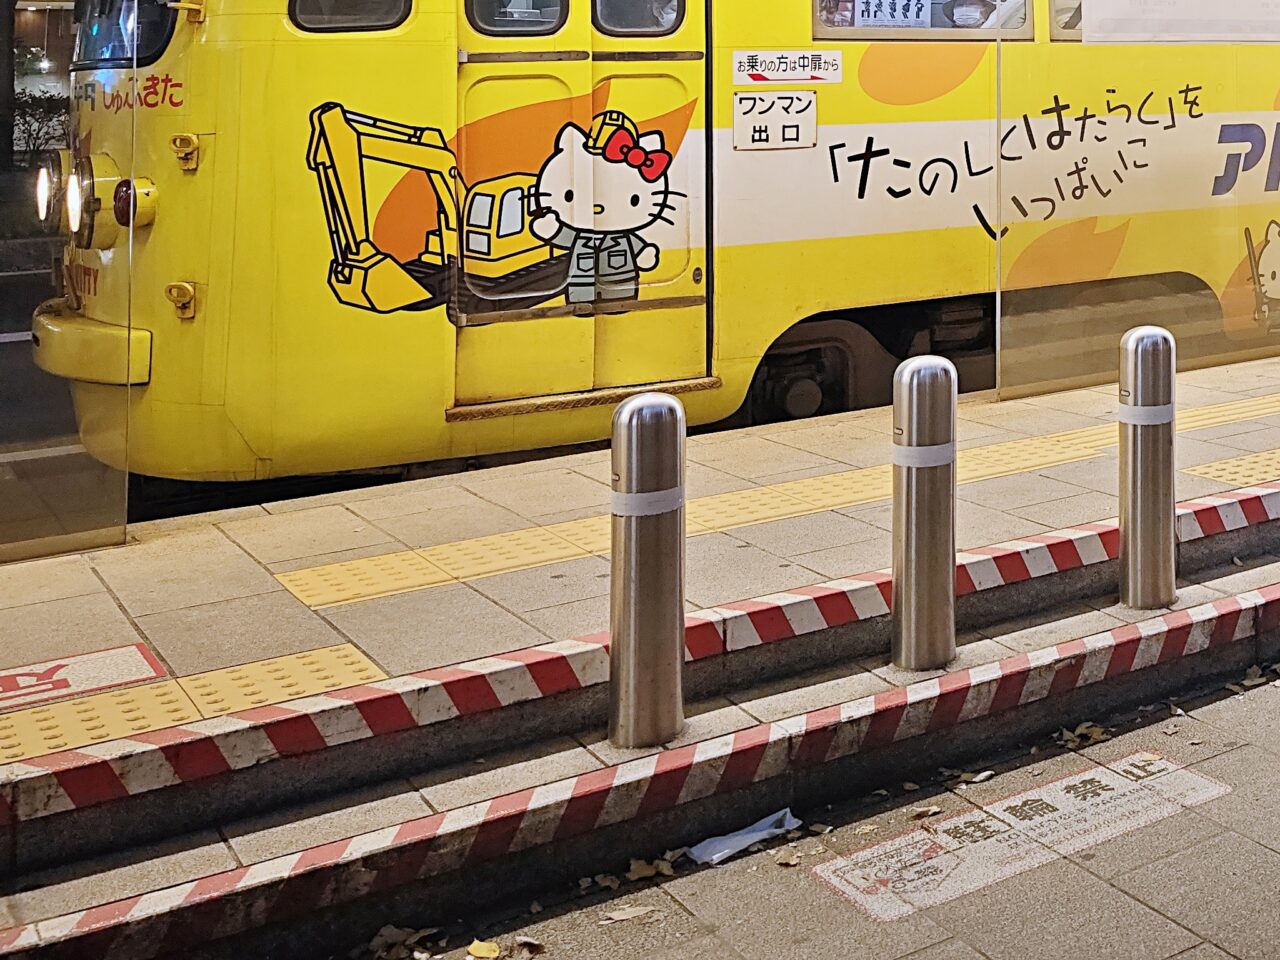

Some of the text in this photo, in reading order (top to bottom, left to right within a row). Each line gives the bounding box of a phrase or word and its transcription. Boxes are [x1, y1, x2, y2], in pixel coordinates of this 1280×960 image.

[737, 54, 839, 73] お乗りの方は中扉から
[738, 96, 812, 116] ワンマン
[751, 124, 800, 144] 出口
[973, 137, 1149, 241] いっぱいに
[942, 756, 1168, 845] 駐輪禁止
